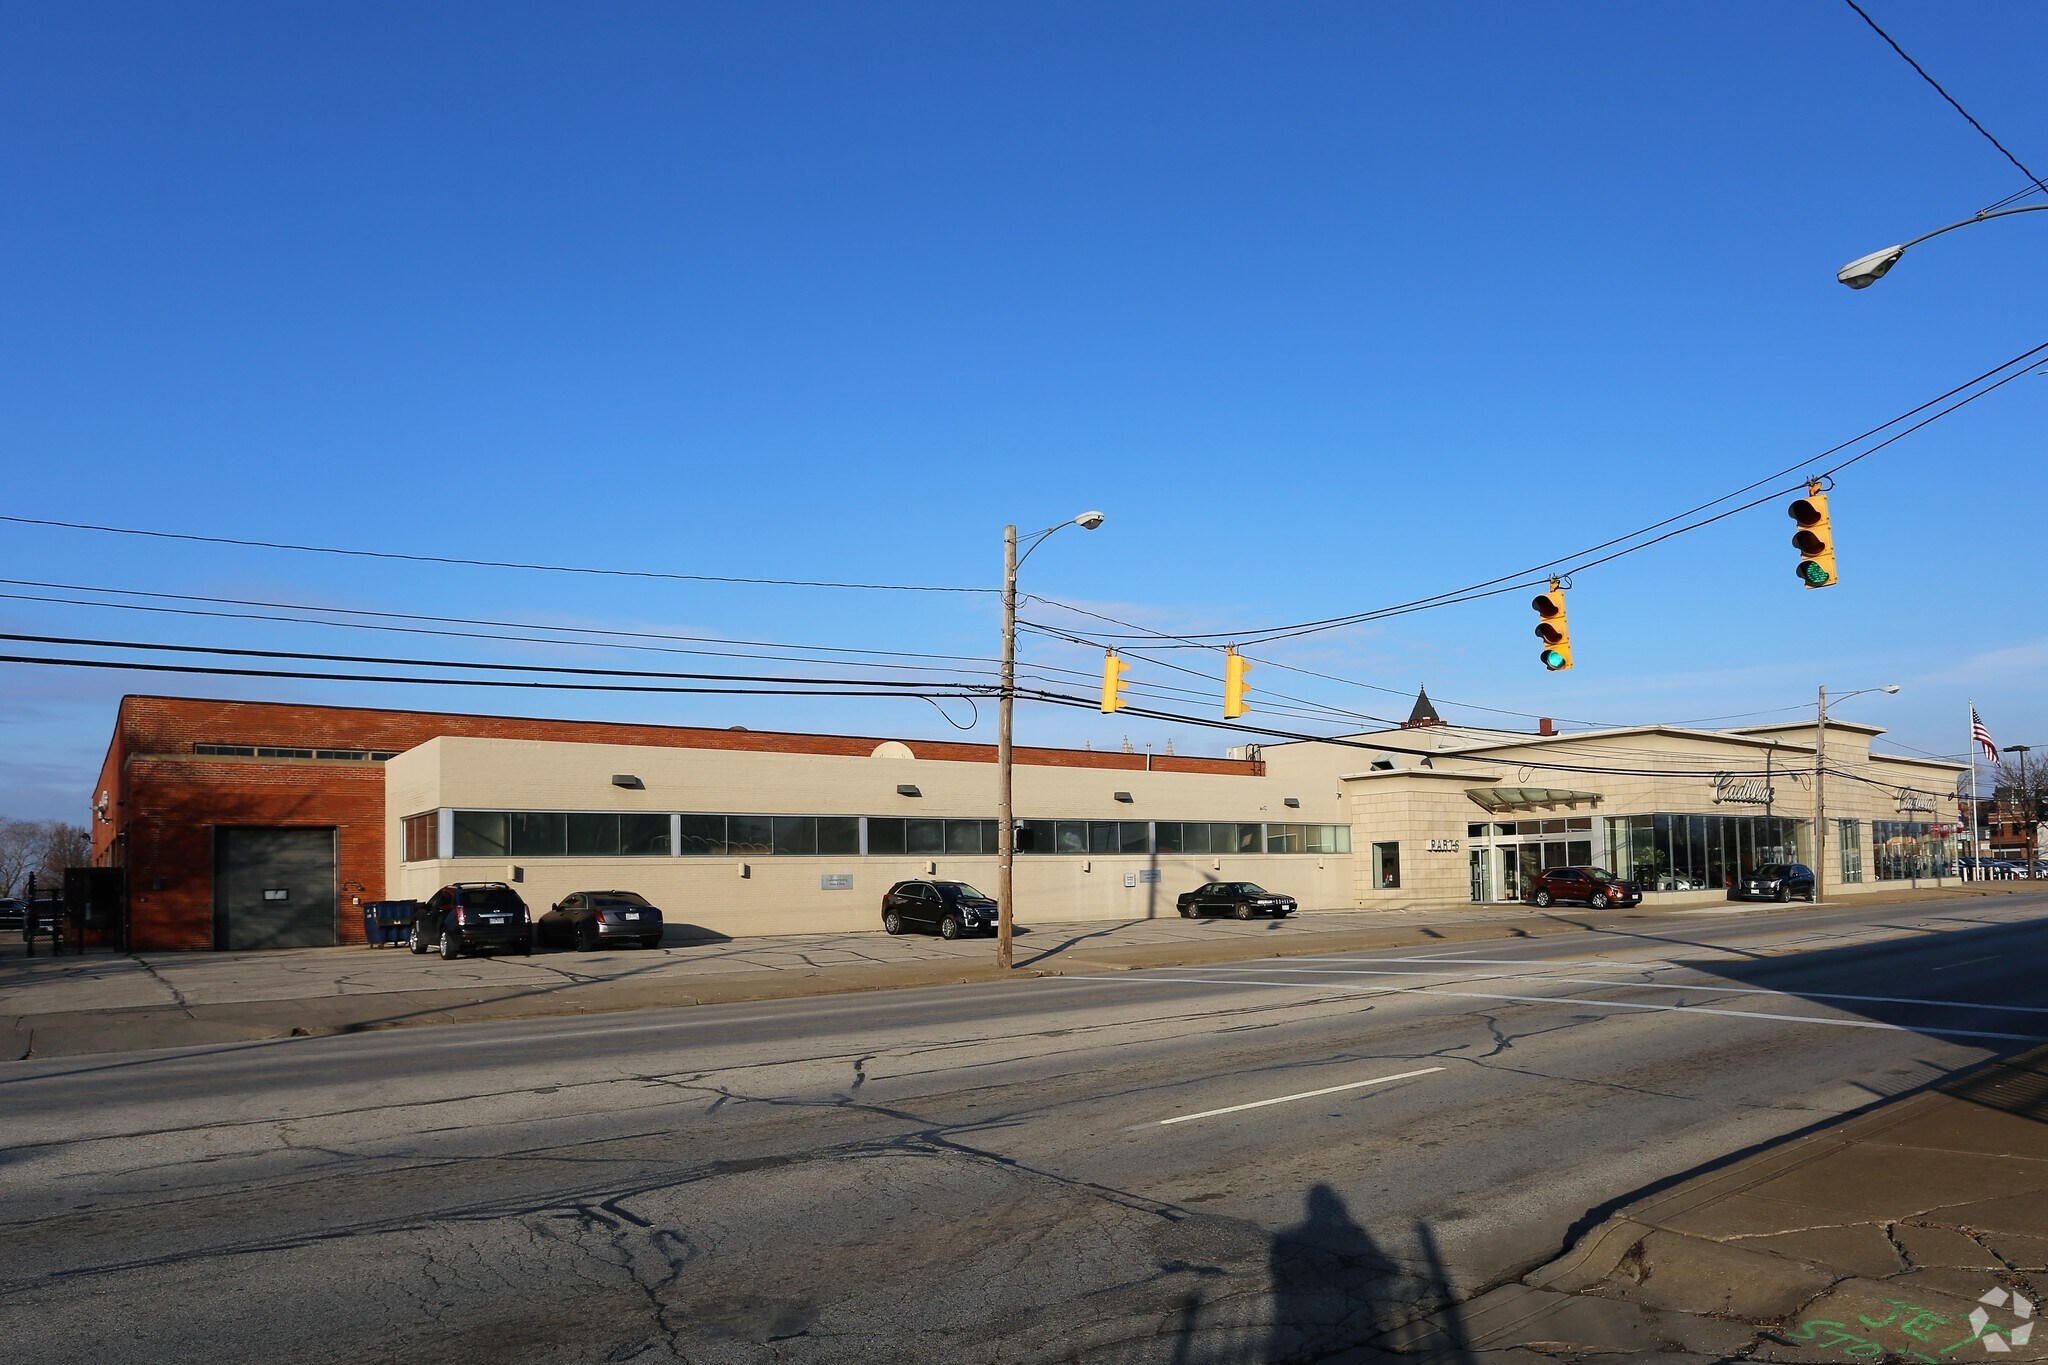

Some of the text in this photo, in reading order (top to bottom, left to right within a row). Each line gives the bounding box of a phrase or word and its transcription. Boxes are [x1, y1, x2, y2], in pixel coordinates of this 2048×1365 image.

[1713, 771, 1775, 803] Cadillac
[1896, 786, 1937, 811] Cadillac
[1431, 839, 1460, 851] PARTS
